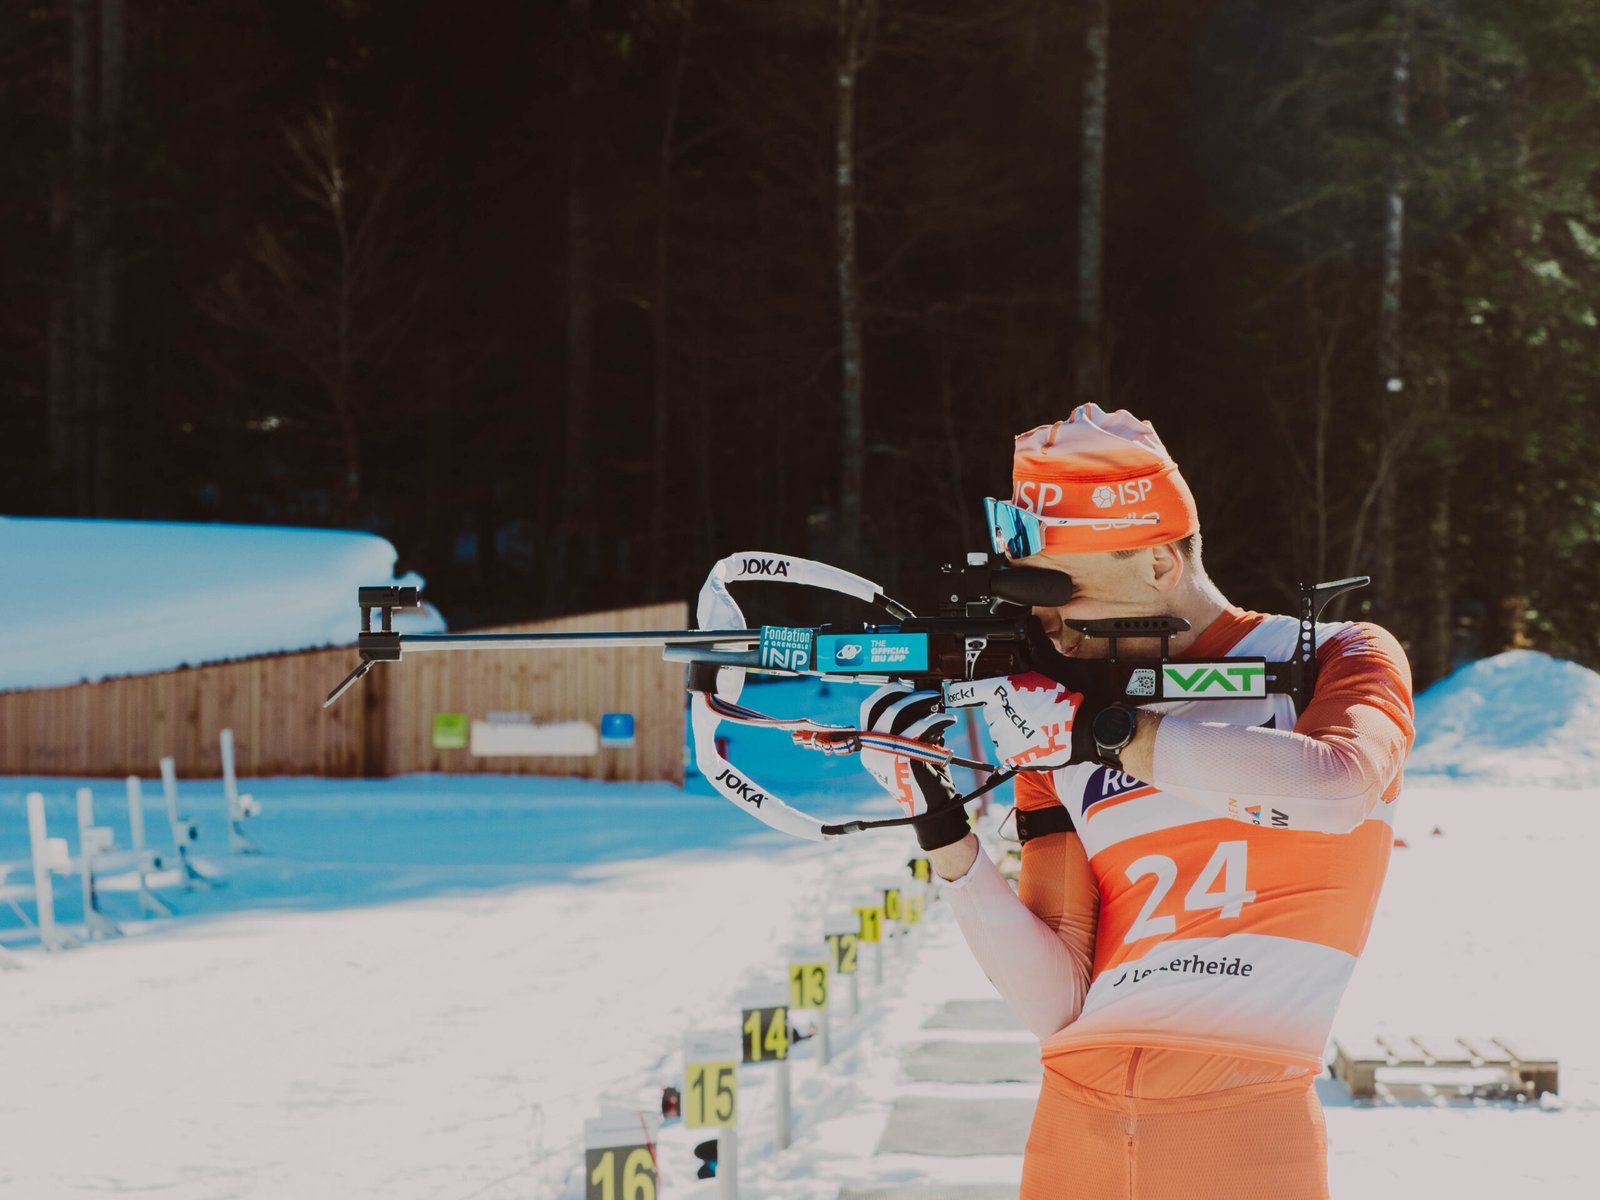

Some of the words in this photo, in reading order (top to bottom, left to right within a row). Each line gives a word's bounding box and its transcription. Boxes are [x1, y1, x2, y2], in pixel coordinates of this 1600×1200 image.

[1118, 478, 1152, 505] ISP
[737, 558, 790, 577] JOKA
[764, 626, 811, 643] Fondation
[771, 640, 809, 650] GRENOBLE
[870, 639, 887, 648] THE
[761, 646, 808, 671] INP
[870, 646, 910, 655] OFFICIAL
[870, 654, 887, 663] IBU
[887, 654, 906, 663] APP
[1163, 667, 1265, 692] VAT
[715, 768, 769, 809] JOKA
[1122, 839, 1257, 945] 24
[828, 935, 858, 973] 12
[793, 967, 827, 1006] 13
[743, 1007, 789, 1062] 14
[692, 1067, 735, 1124] 15
[591, 1148, 656, 1200] 16
